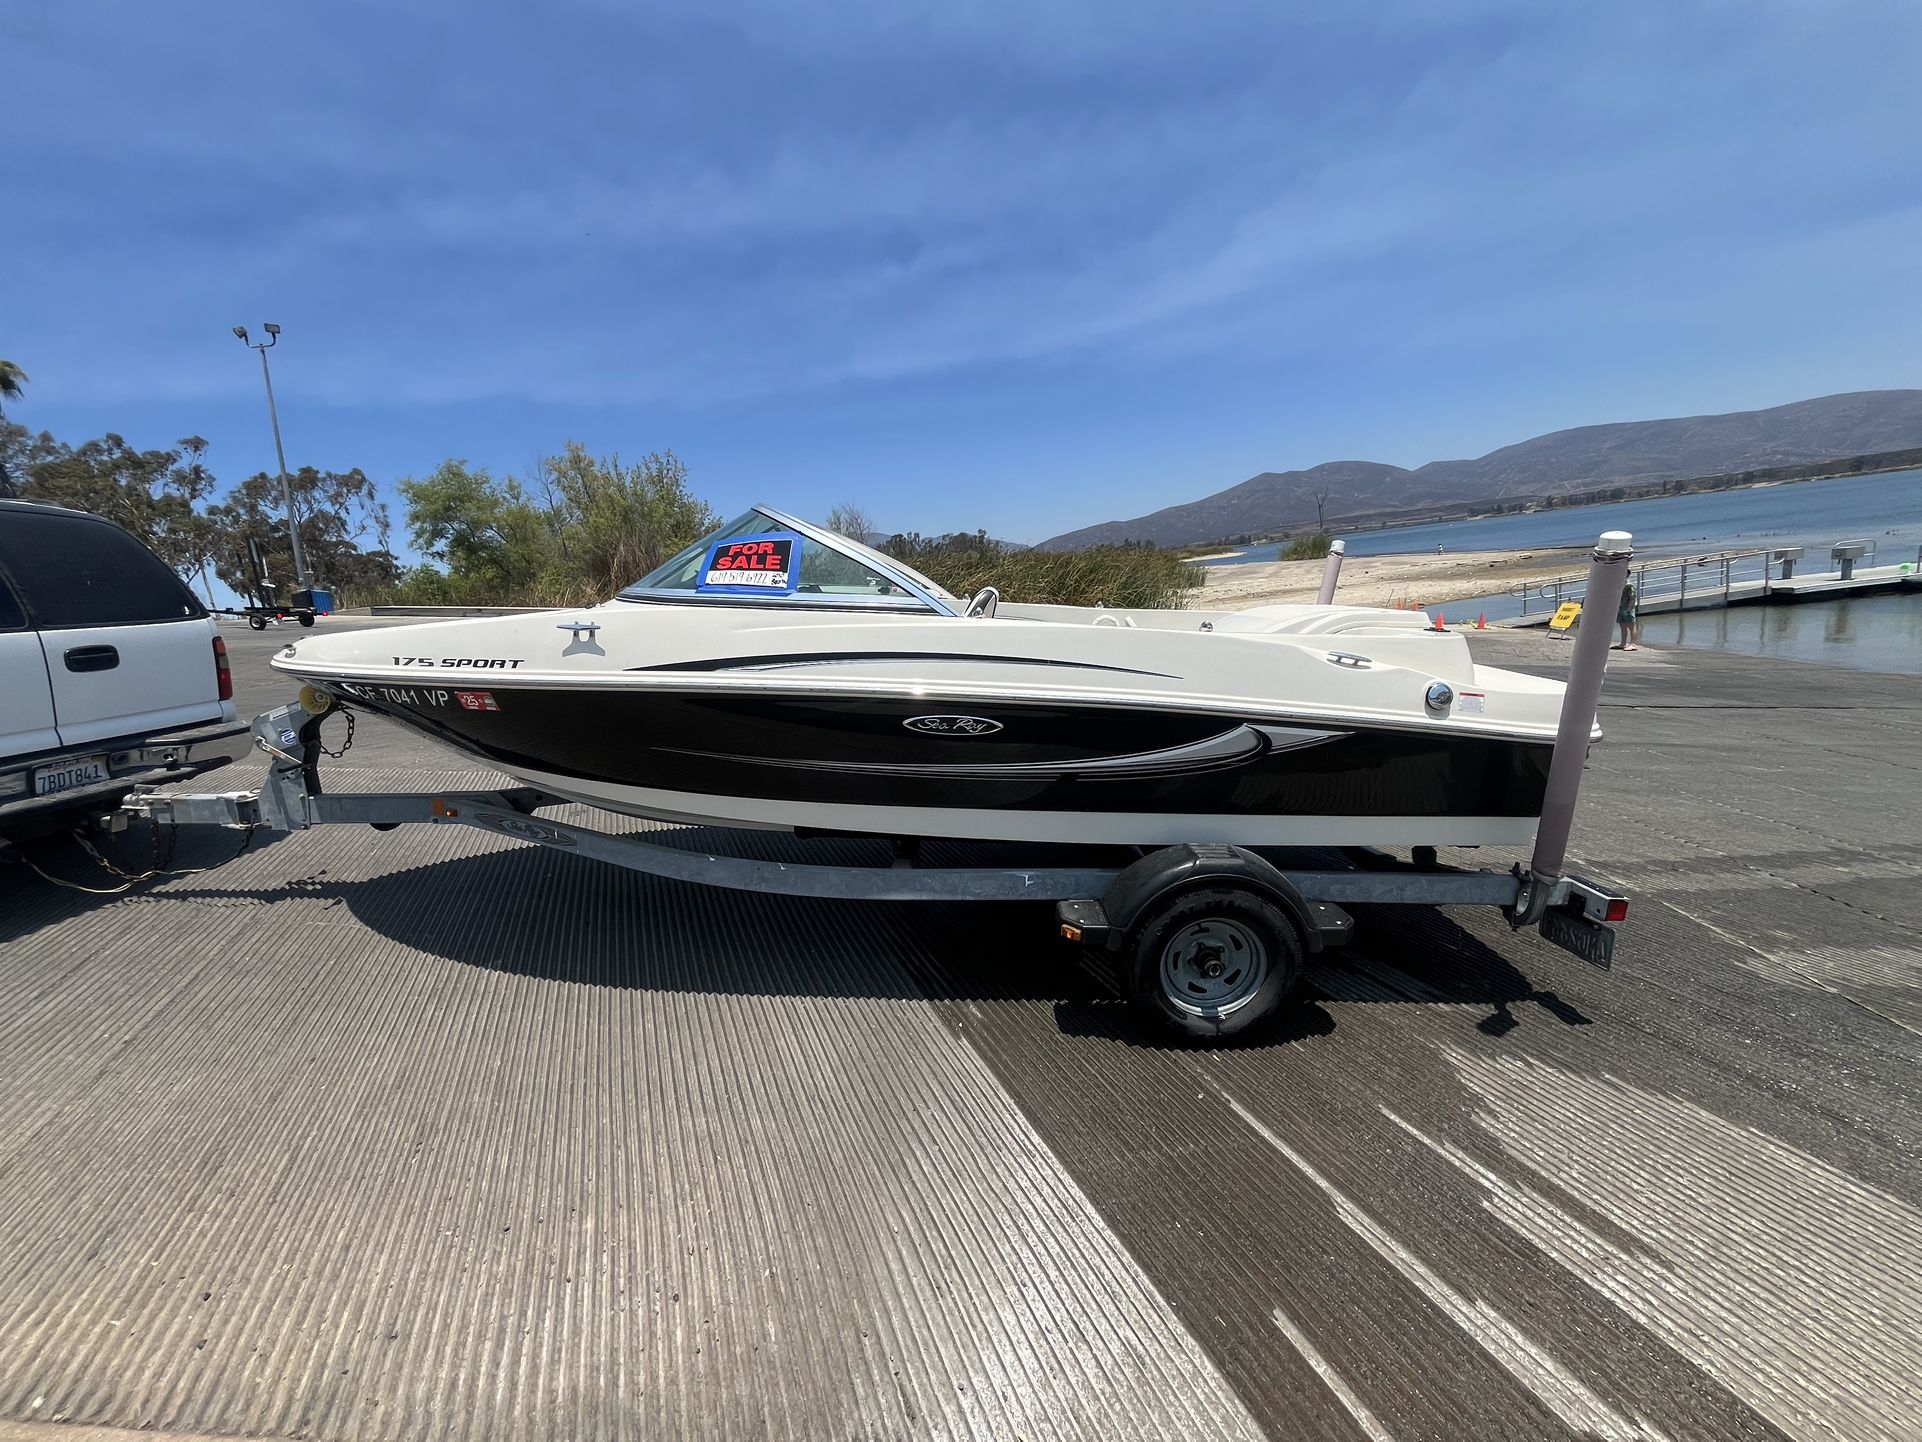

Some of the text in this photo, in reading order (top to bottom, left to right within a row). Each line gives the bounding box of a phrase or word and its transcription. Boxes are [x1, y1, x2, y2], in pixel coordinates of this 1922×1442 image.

[728, 542, 775, 556] FOR
[716, 555, 782, 570] SALE
[392, 656, 525, 669] 175 SPORT
[355, 685, 449, 707] CF 7041 VP
[463, 695, 479, 706] 25
[917, 718, 988, 734] Sea Ray
[37, 764, 103, 792] 7BDT841
